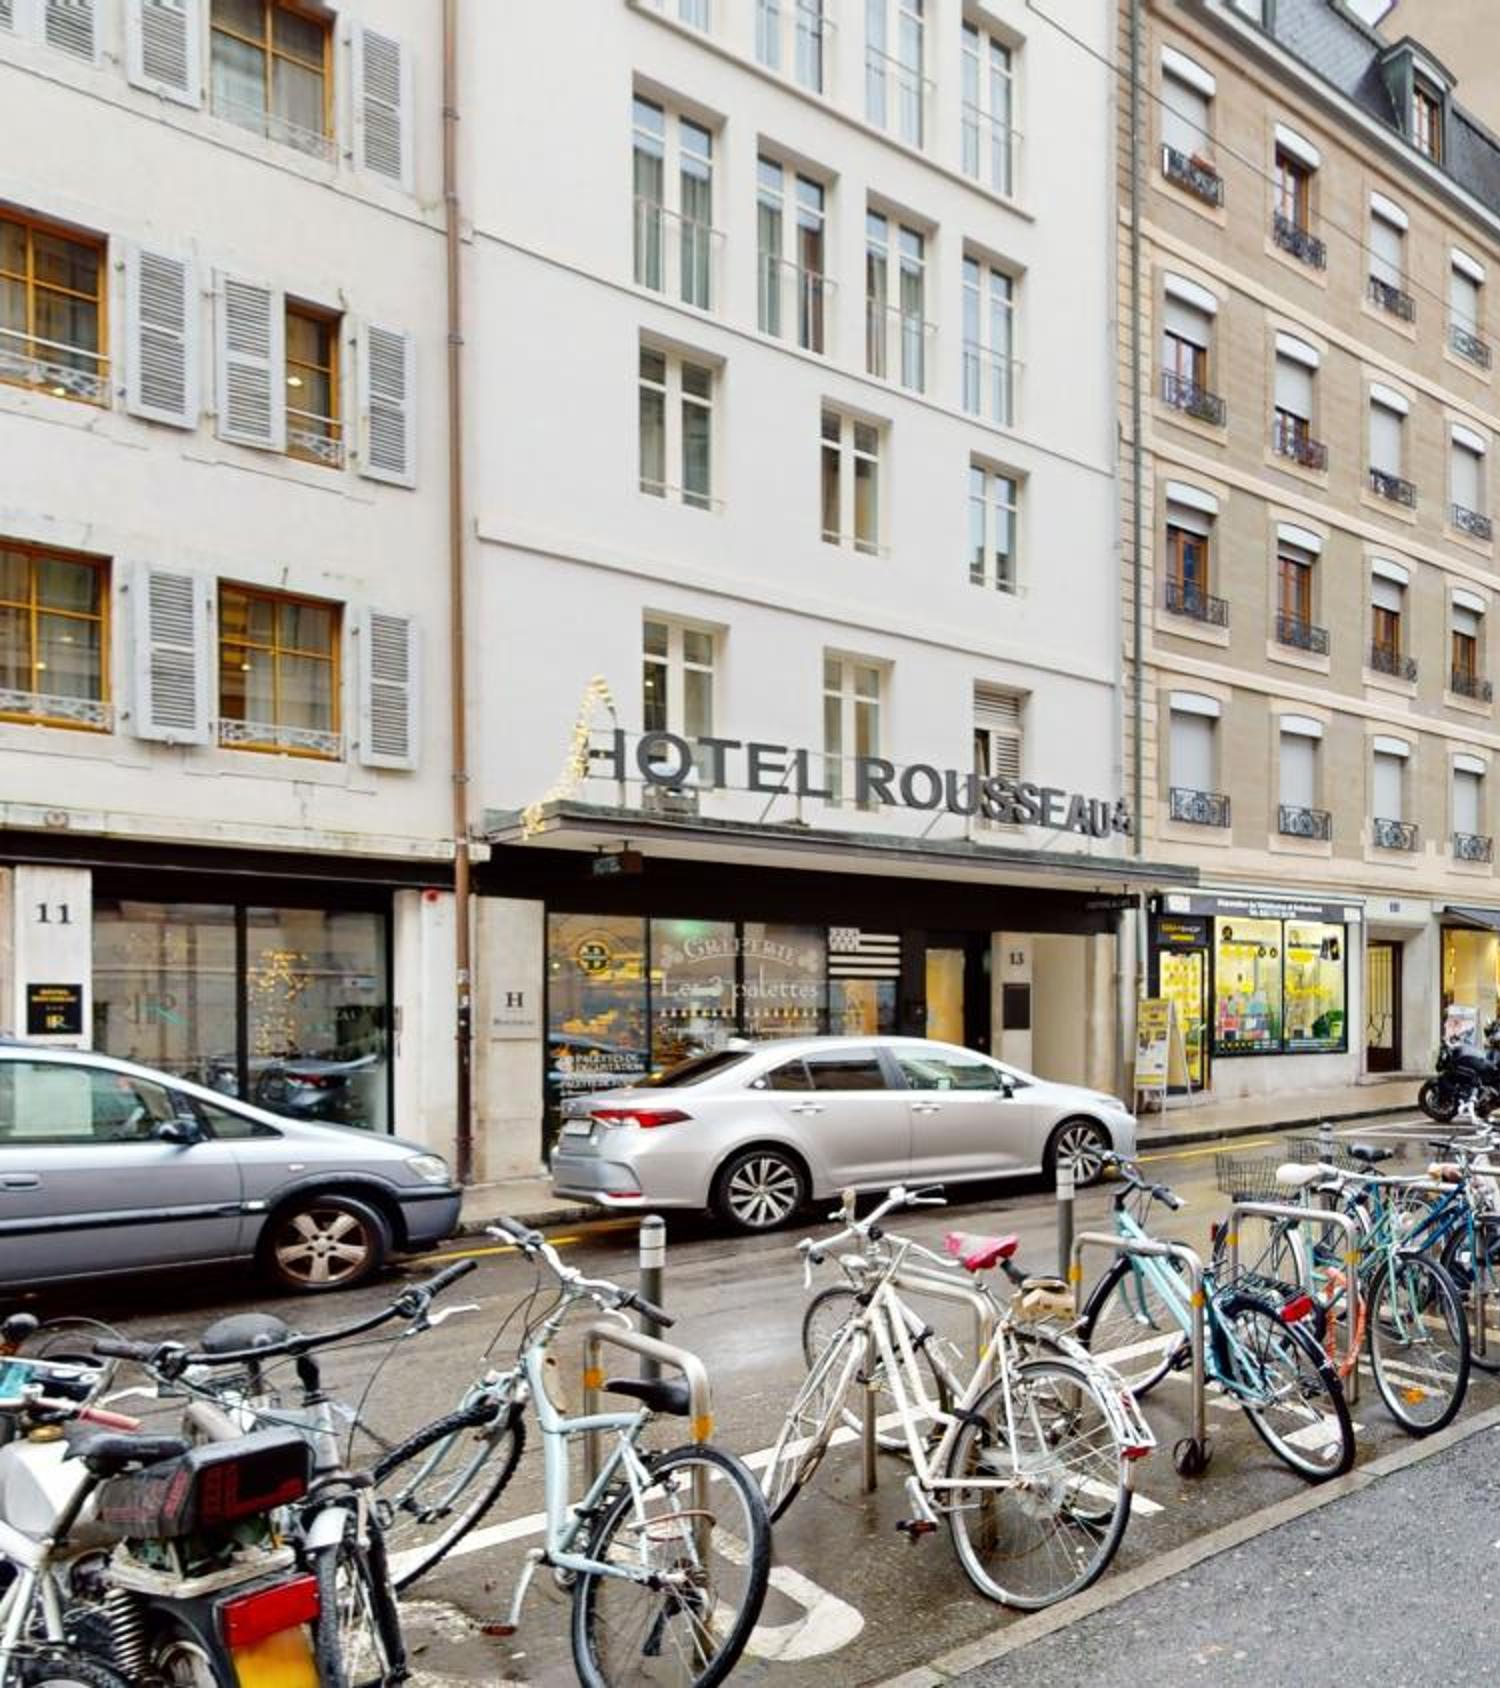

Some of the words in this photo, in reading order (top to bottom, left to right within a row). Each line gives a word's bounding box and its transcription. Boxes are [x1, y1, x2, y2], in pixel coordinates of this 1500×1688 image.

[583, 728, 833, 799] HOTEL
[855, 756, 1111, 839] ROUSSEAU
[36, 903, 71, 925] 11
[506, 991, 524, 1008] H
